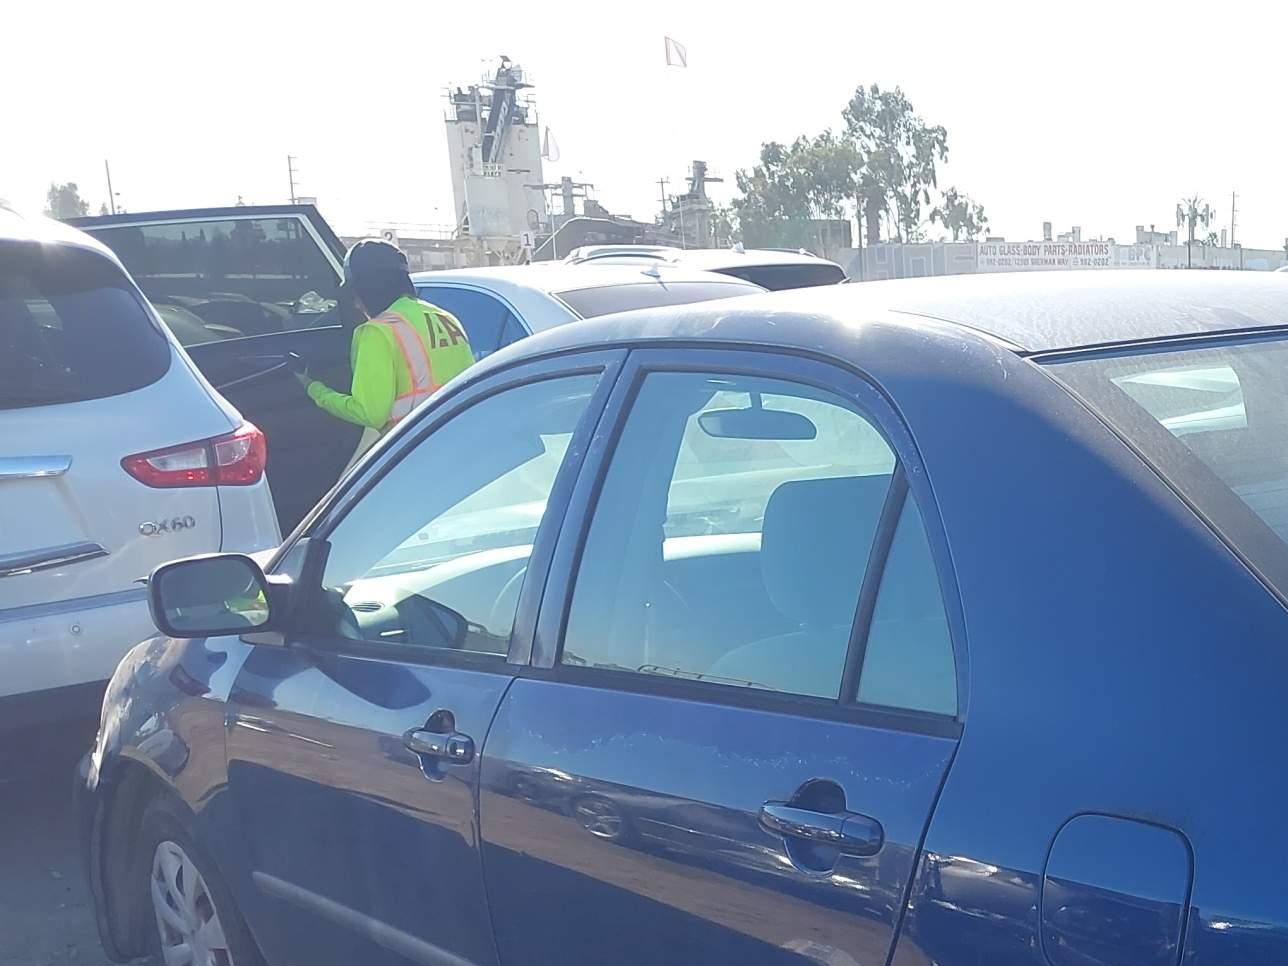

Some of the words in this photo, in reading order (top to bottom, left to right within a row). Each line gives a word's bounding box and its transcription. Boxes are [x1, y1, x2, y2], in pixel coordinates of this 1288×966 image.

[522, 233, 532, 247] 1
[979, 244, 996, 256] AUTO
[139, 515, 196, 536] QX60
